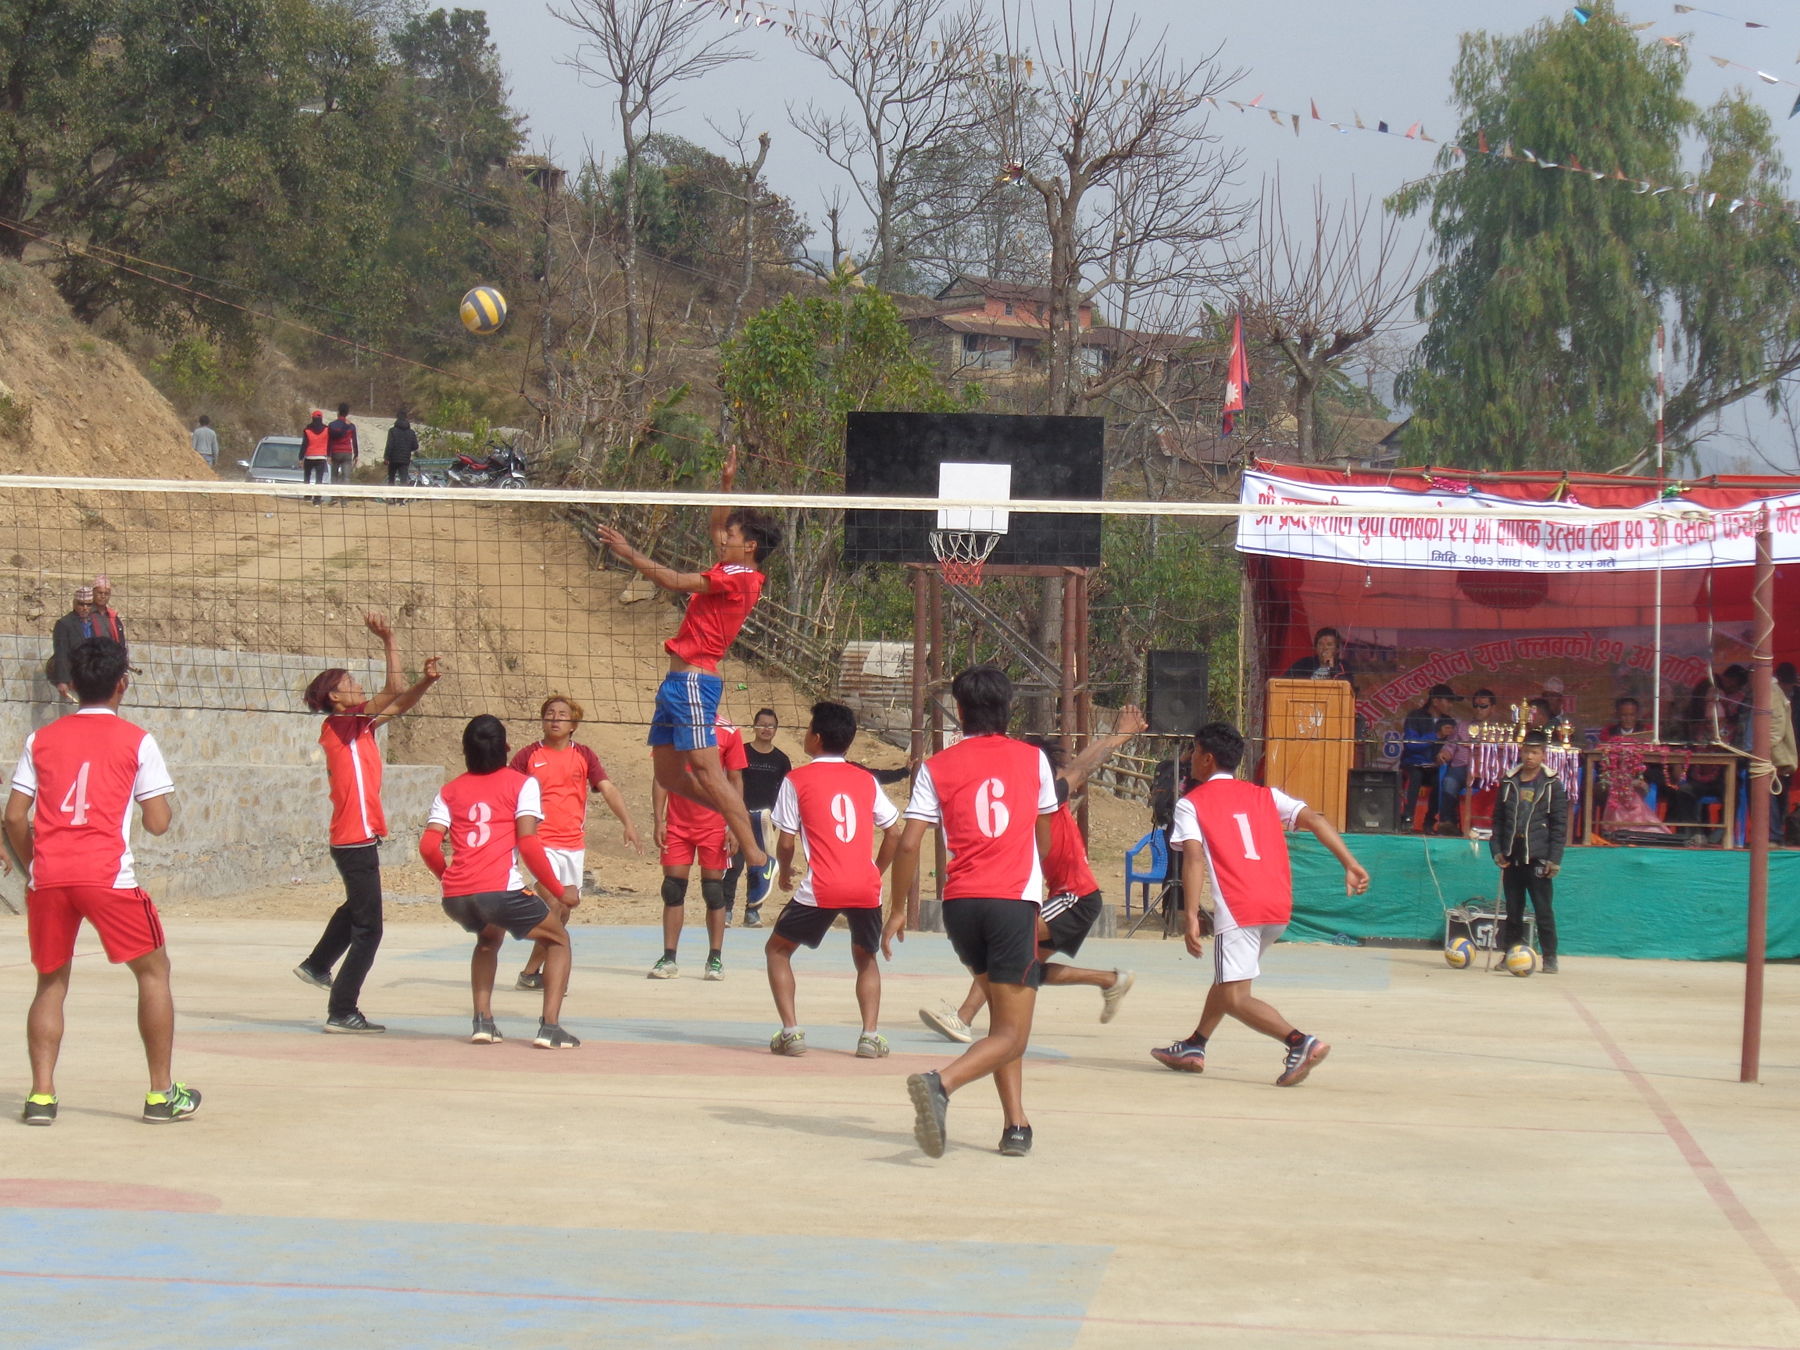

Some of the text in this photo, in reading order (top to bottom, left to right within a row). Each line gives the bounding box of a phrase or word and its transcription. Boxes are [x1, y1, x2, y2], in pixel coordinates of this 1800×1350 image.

[1591, 520, 1621, 552] तथा
[1465, 555, 1494, 567] २०७३
[60, 762, 91, 826] 4
[830, 793, 857, 844] 9
[975, 777, 1010, 839] 6
[466, 802, 492, 848] 3
[1232, 812, 1262, 861] 1
